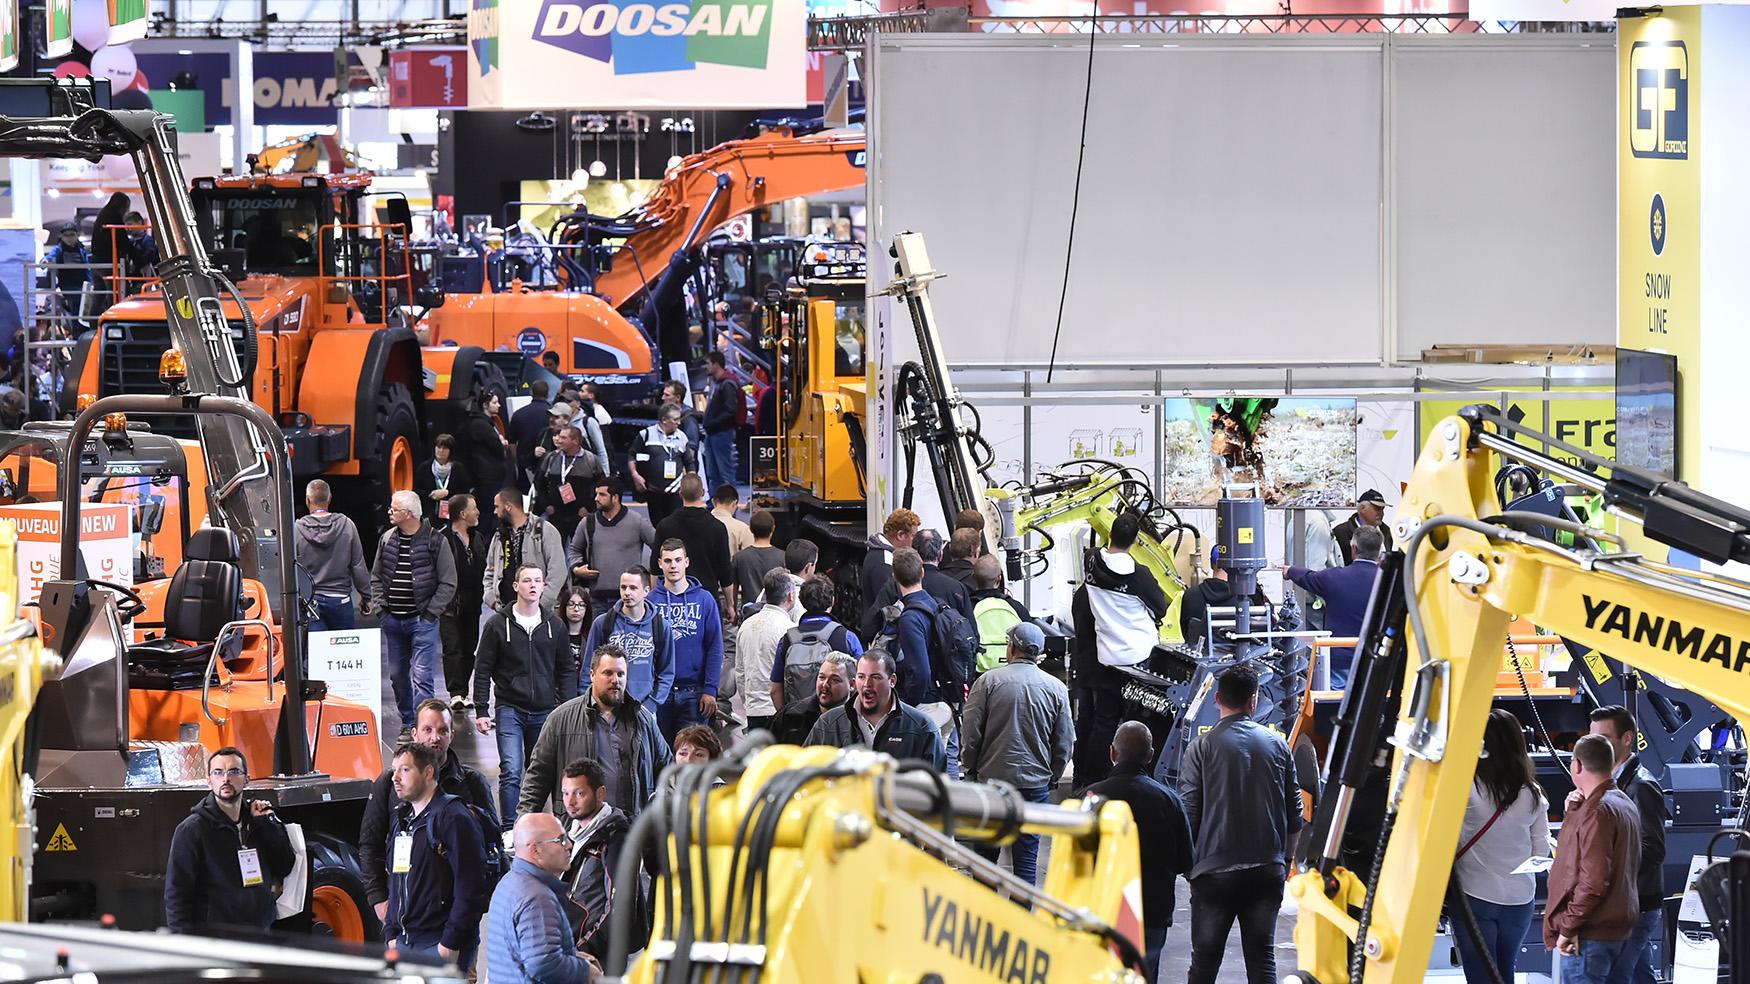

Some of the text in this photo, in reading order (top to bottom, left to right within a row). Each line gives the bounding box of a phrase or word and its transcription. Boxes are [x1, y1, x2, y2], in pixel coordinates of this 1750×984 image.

[541, 4, 766, 37] DOOSAN
[227, 198, 297, 209] DOOSAN
[1645, 272, 1671, 299] SNOW
[1649, 307, 1667, 334] LINE
[111, 466, 142, 474] AUSA
[82, 514, 116, 533] NEW
[327, 659, 363, 670] T 144 H
[354, 722, 368, 735] AHG
[923, 886, 1050, 984] YANMAR
